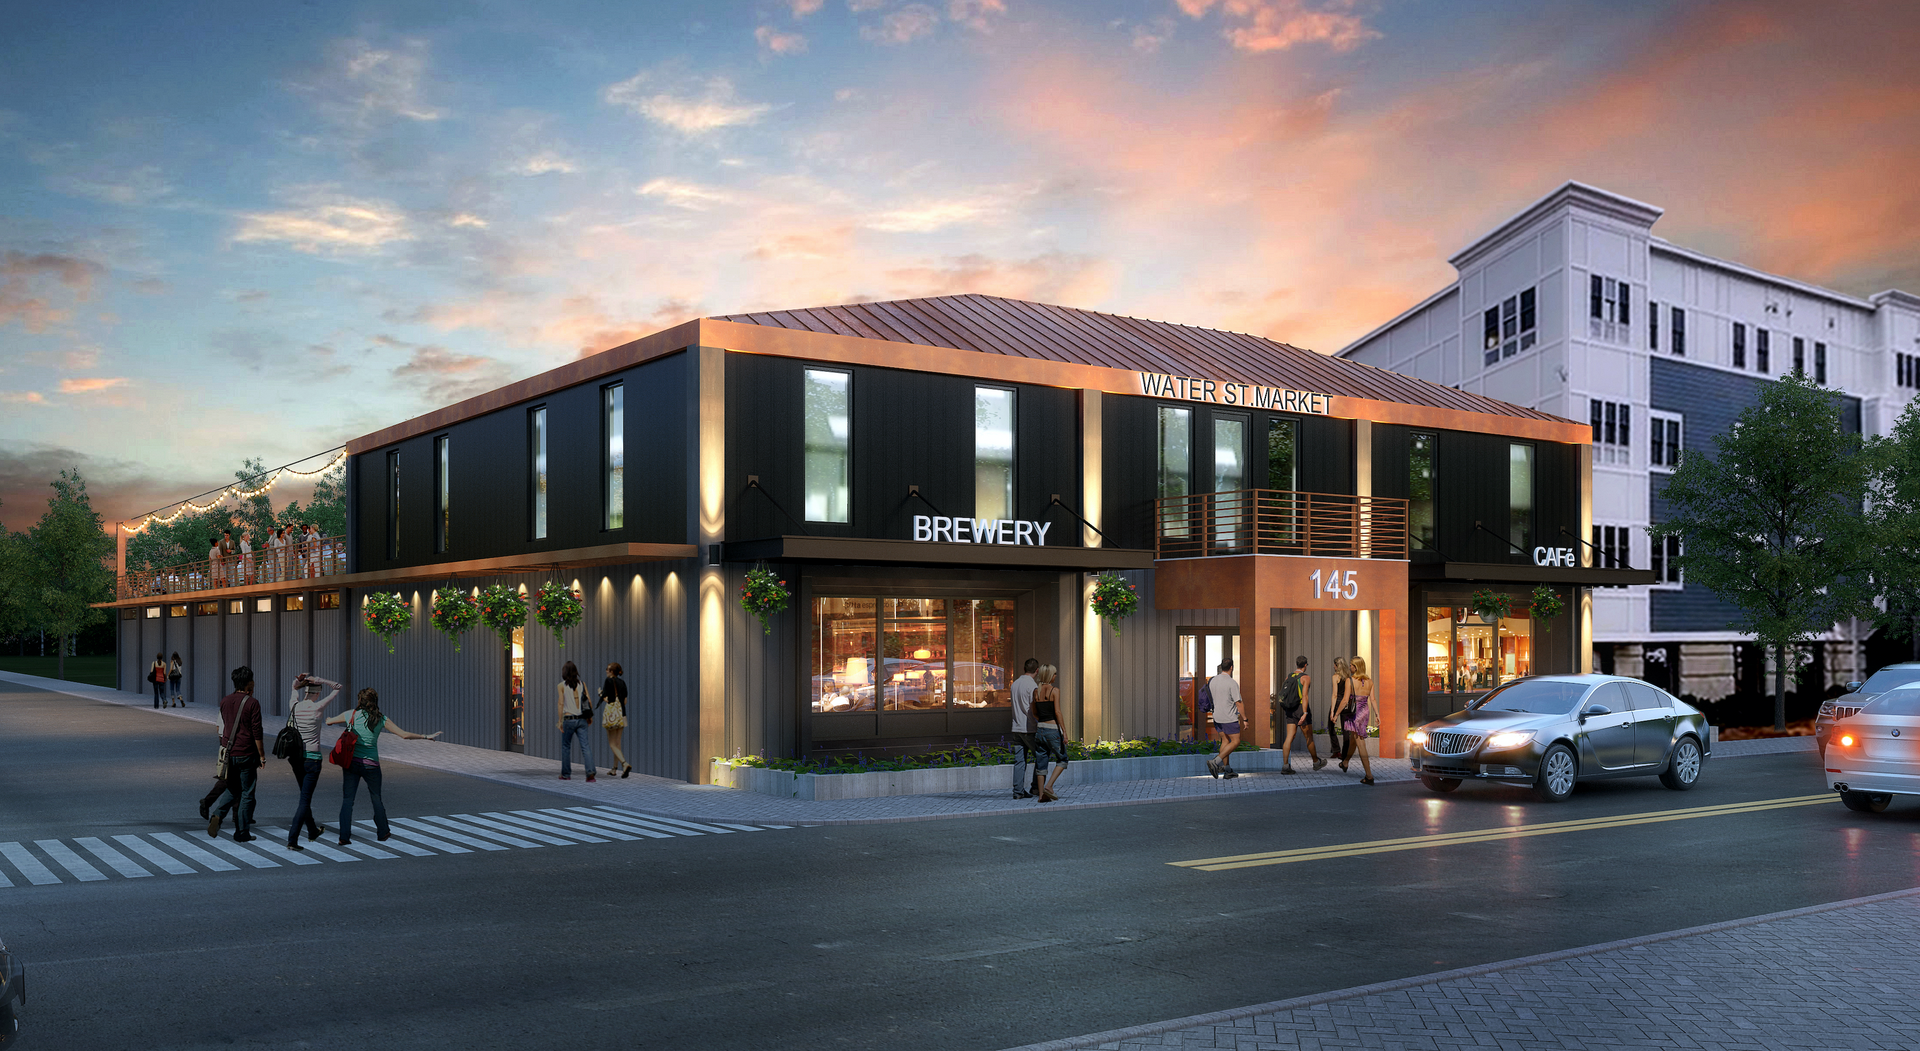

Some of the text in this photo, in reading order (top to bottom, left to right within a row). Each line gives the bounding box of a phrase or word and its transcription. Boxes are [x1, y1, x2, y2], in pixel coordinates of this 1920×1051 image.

[1139, 372, 1217, 402] WATER
[913, 514, 1052, 547] BREWERY
[1533, 546, 1576, 568] CAFé
[1309, 568, 1358, 600] 145
